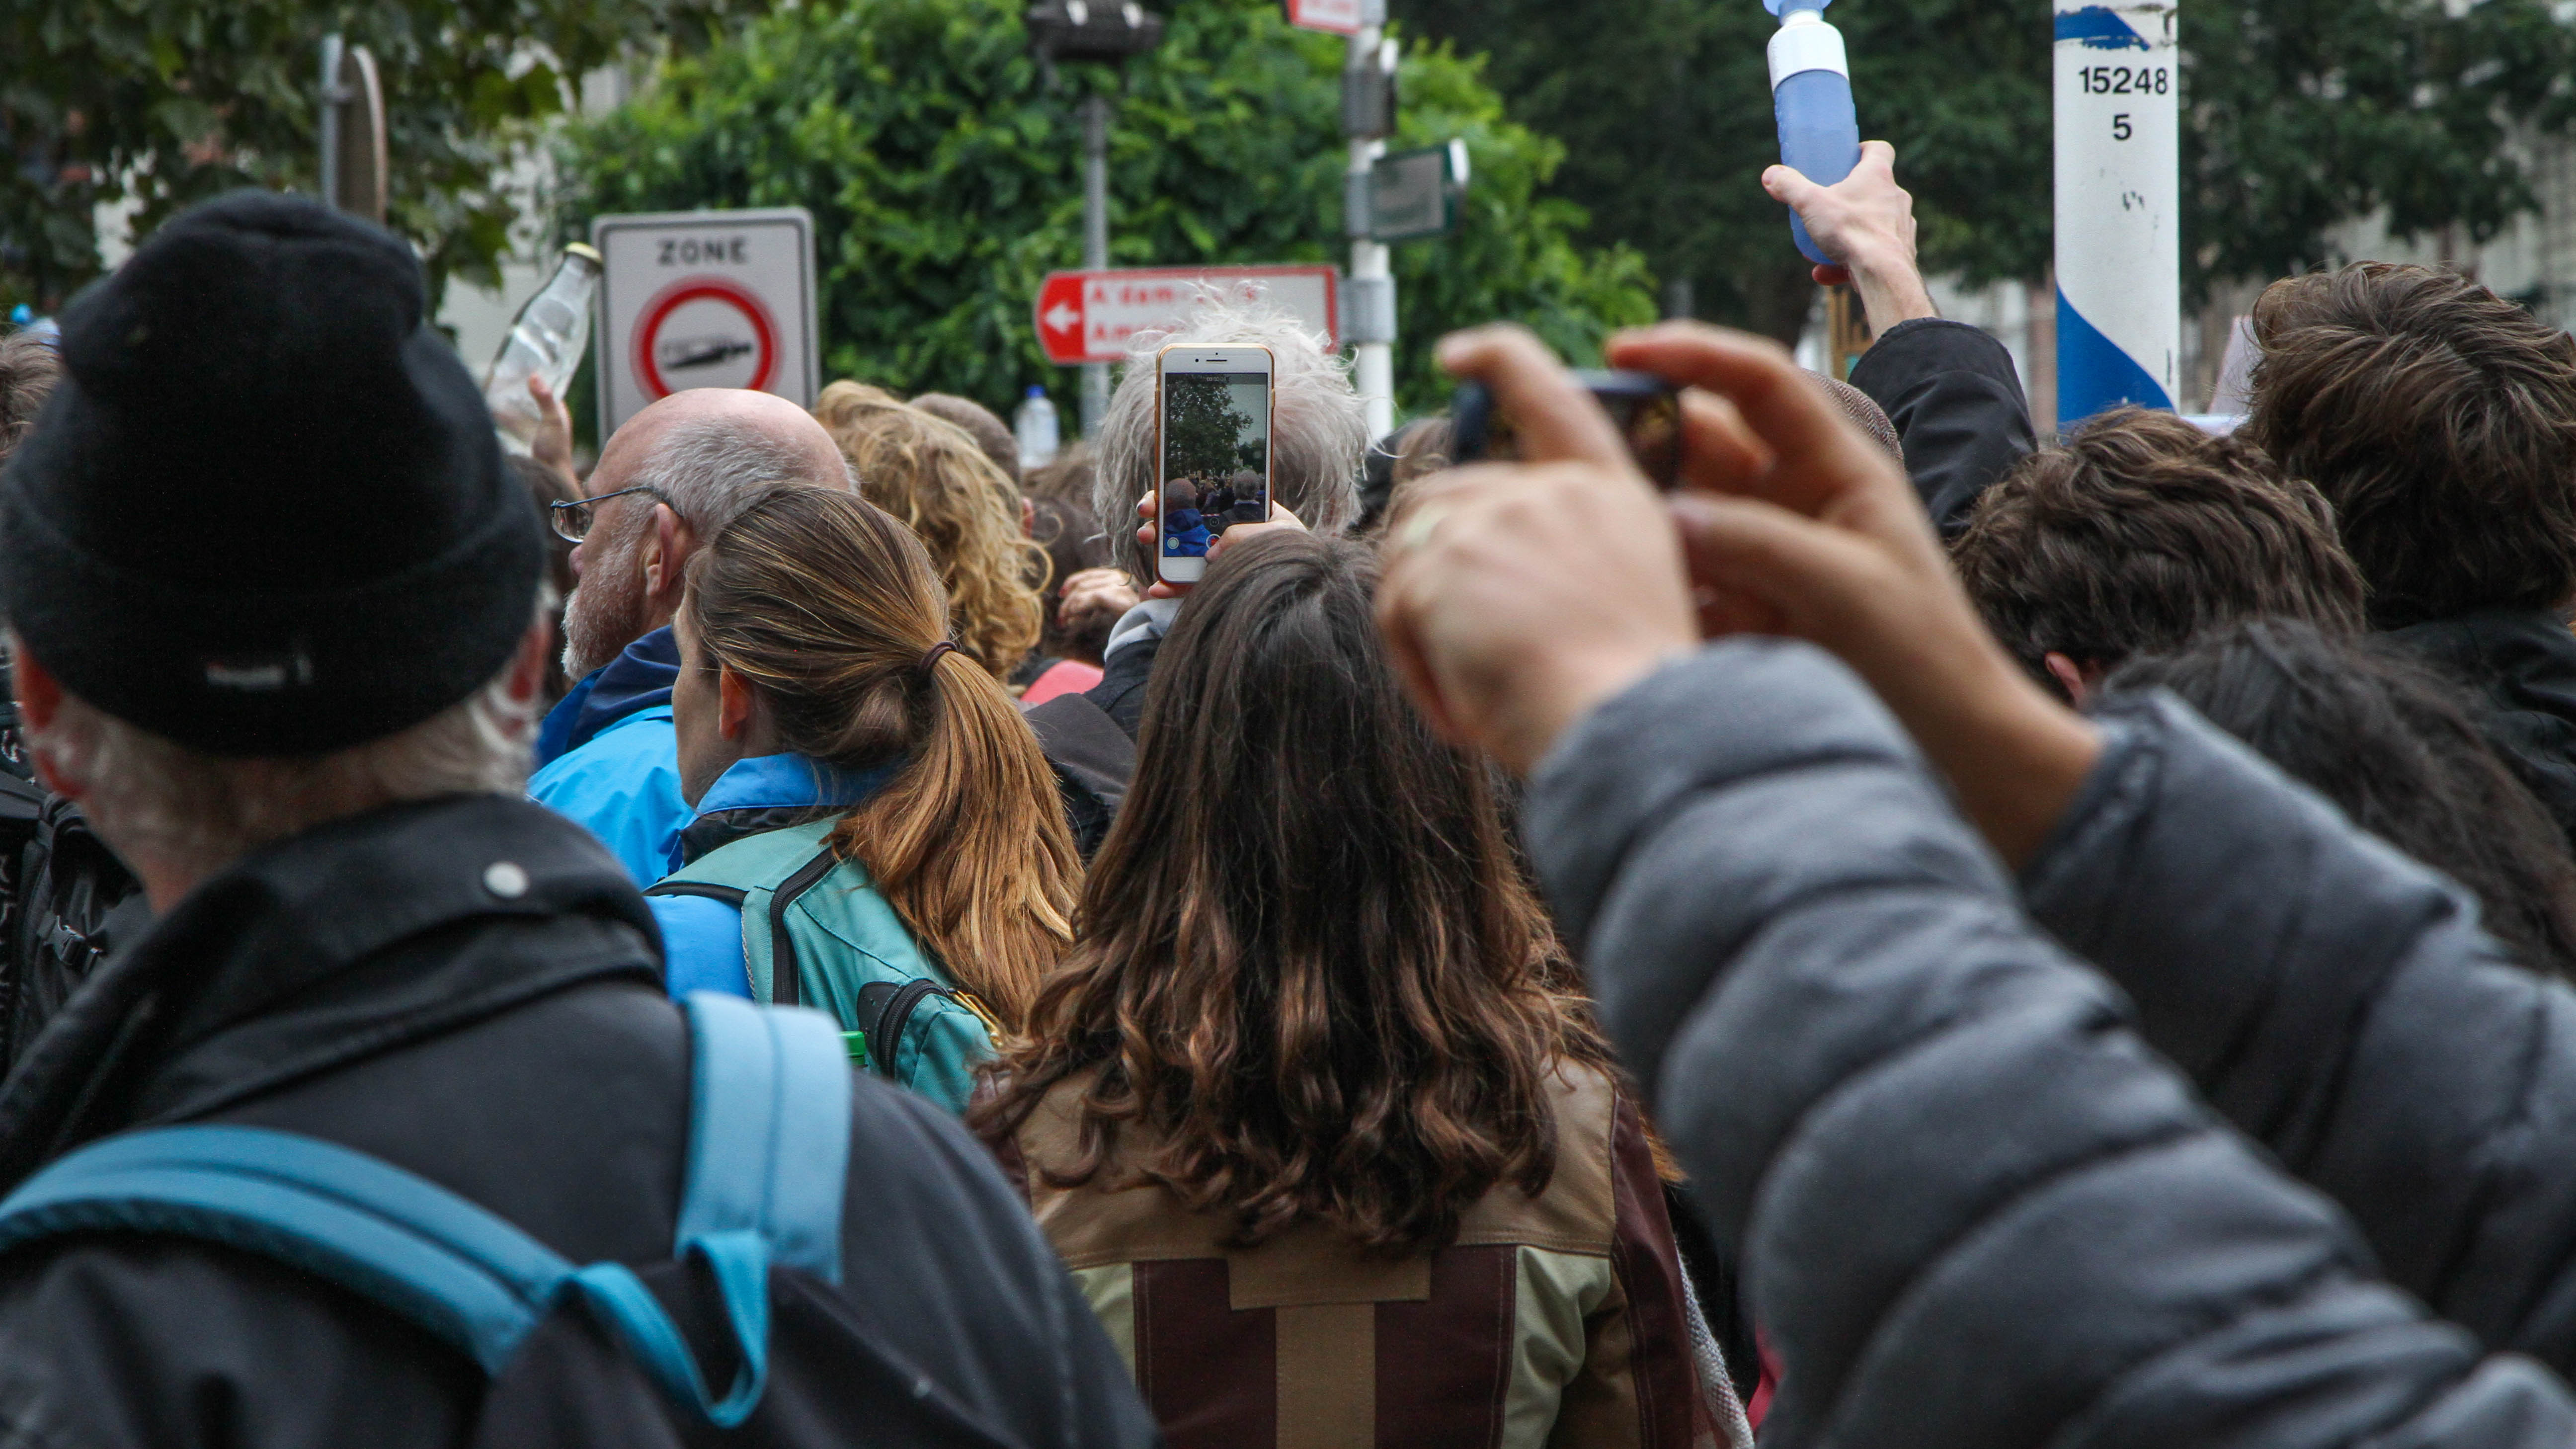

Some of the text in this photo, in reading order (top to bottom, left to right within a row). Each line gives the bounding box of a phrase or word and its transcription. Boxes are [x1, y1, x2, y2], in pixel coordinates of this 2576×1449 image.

[2079, 67, 2168, 95] 15248
[2113, 114, 2132, 141] 5
[658, 238, 747, 264] ZONE
